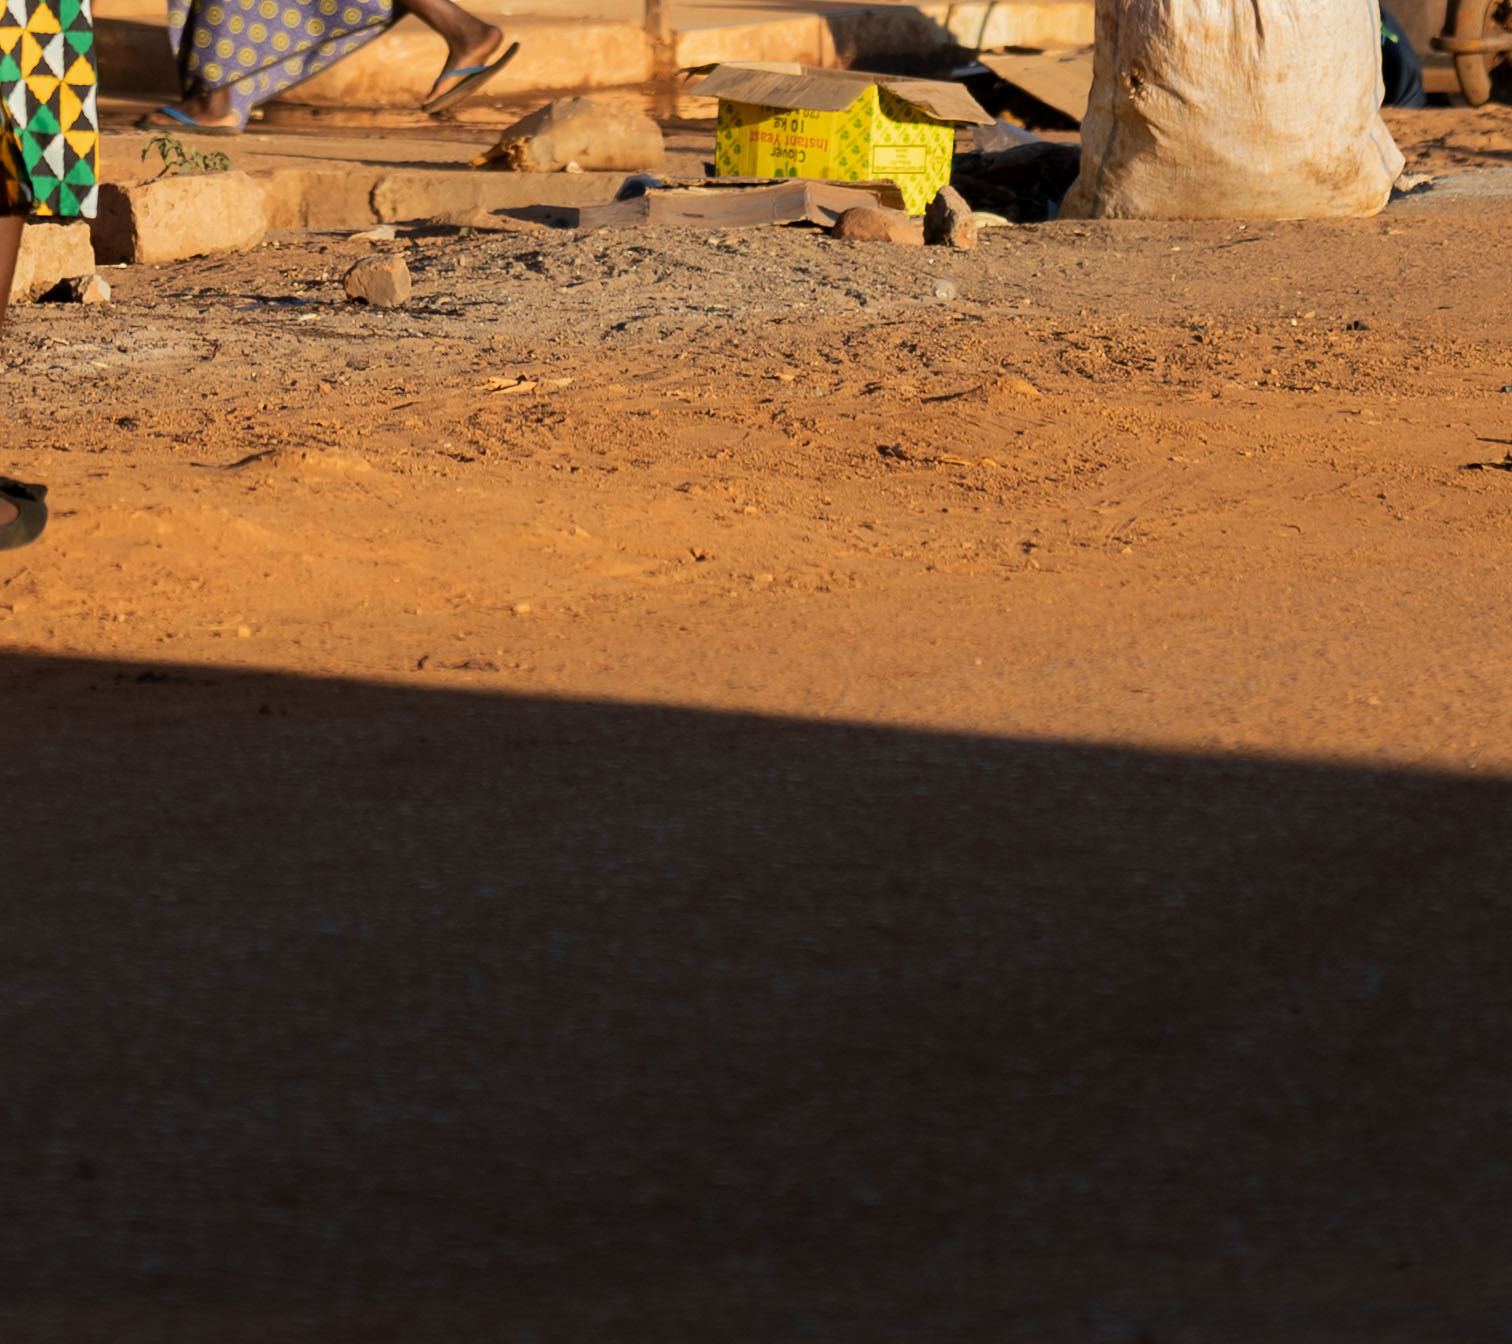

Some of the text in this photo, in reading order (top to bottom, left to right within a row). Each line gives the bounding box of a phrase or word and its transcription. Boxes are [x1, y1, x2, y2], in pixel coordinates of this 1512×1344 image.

[773, 117, 805, 134] 10 kg
[749, 129, 828, 153] Instant Yeast
[770, 146, 806, 163] Clover
